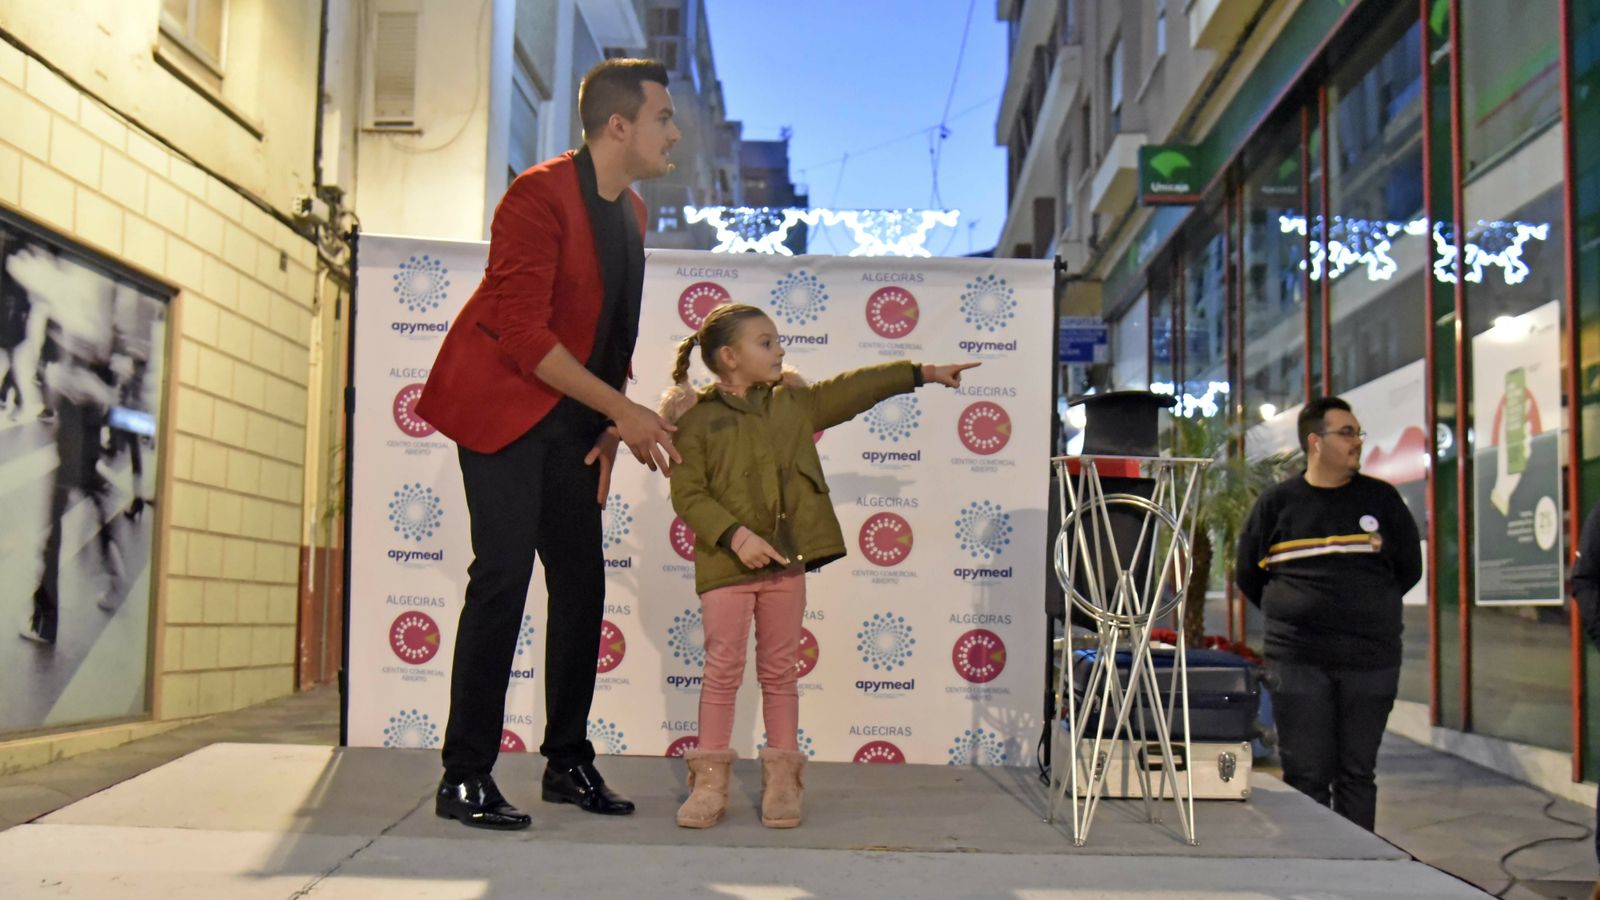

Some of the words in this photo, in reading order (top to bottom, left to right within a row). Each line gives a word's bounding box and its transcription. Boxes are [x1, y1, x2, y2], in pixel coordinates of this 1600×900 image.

[676, 267, 738, 279] ALGECIRAS
[861, 272, 924, 284] ALGECIRAS
[391, 321, 448, 334] apymeal
[777, 334, 828, 346] pymeal
[958, 340, 1017, 352] apymeal
[389, 368, 430, 379] ALGECI
[862, 450, 921, 463] apymeal
[856, 497, 919, 508] ALGECIRAS
[387, 549, 443, 562] apymeal
[953, 566, 1013, 580] apymeal
[386, 595, 445, 608] ALGECIRAS
[949, 613, 1012, 624] ALGECIRAS
[666, 675, 704, 687] apym
[855, 678, 915, 692] apymeal
[661, 720, 698, 731] ALGEC
[849, 725, 912, 737] ALGECIRAS
